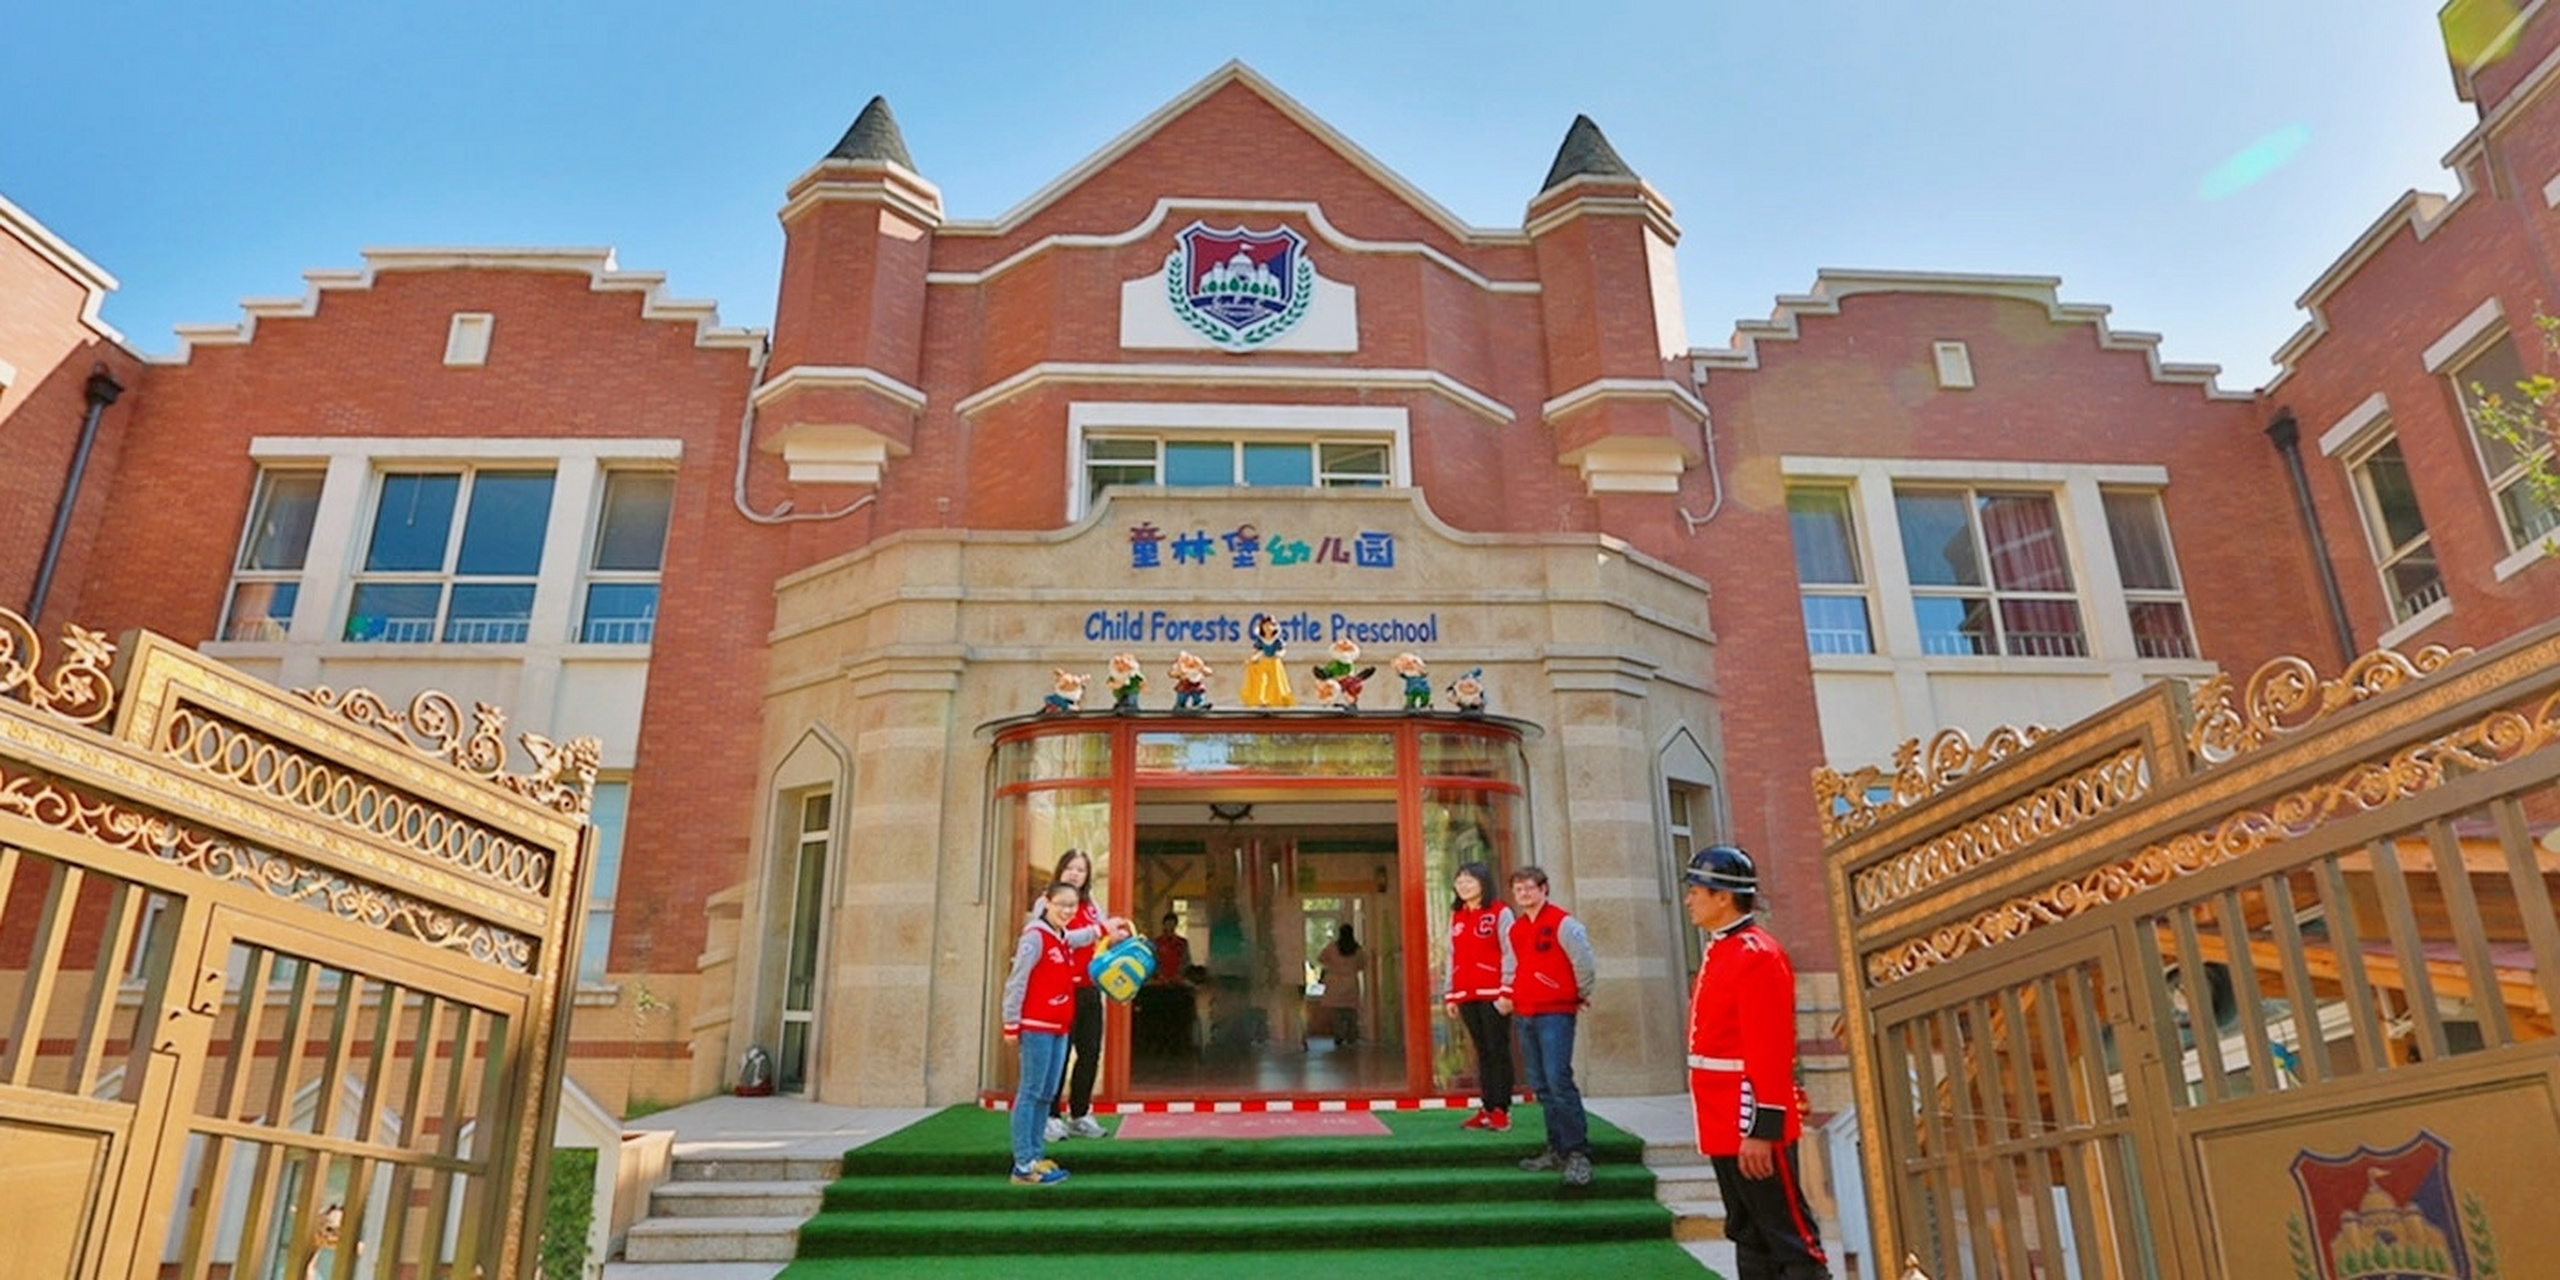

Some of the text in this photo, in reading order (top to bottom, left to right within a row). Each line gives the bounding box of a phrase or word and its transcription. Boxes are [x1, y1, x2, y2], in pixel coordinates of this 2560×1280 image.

[1130, 522, 1394, 568] 童林堡幼儿园
[1085, 612, 1437, 643] Child Forests Cstle Preschool
